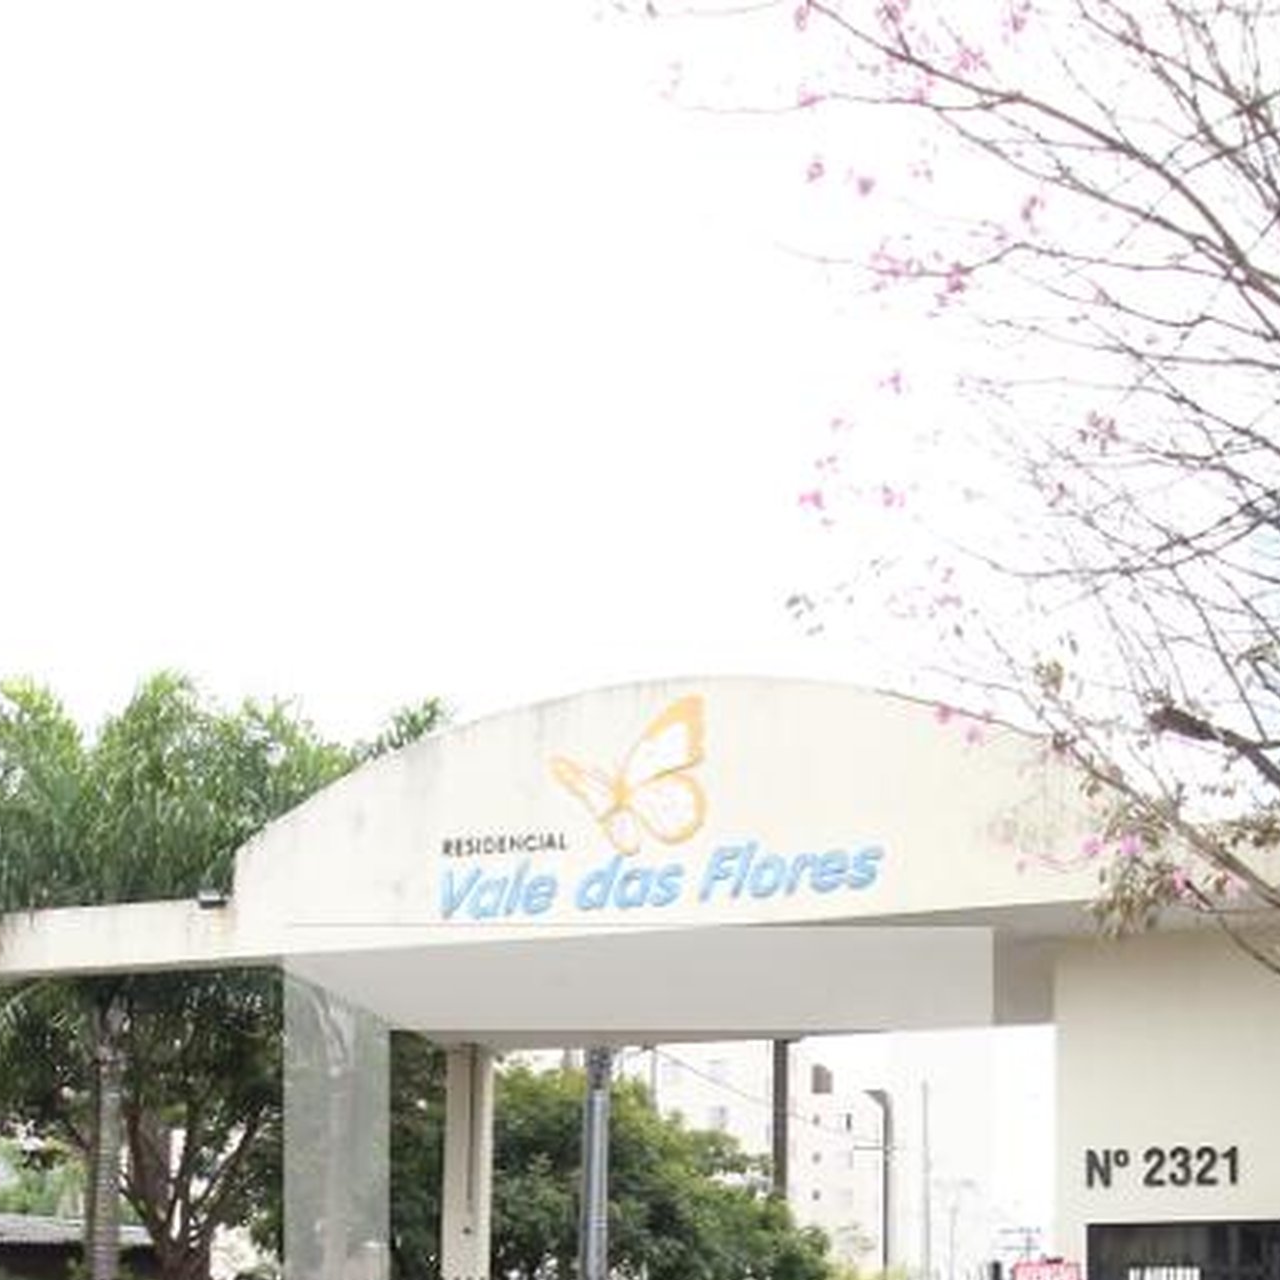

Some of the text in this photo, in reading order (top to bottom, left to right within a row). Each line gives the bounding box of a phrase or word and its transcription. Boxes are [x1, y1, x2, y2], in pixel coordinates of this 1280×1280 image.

[442, 833, 568, 857] RESIDENCIAL
[439, 840, 886, 920] Vale das Flores
[1143, 1145, 1238, 1187] 2321
